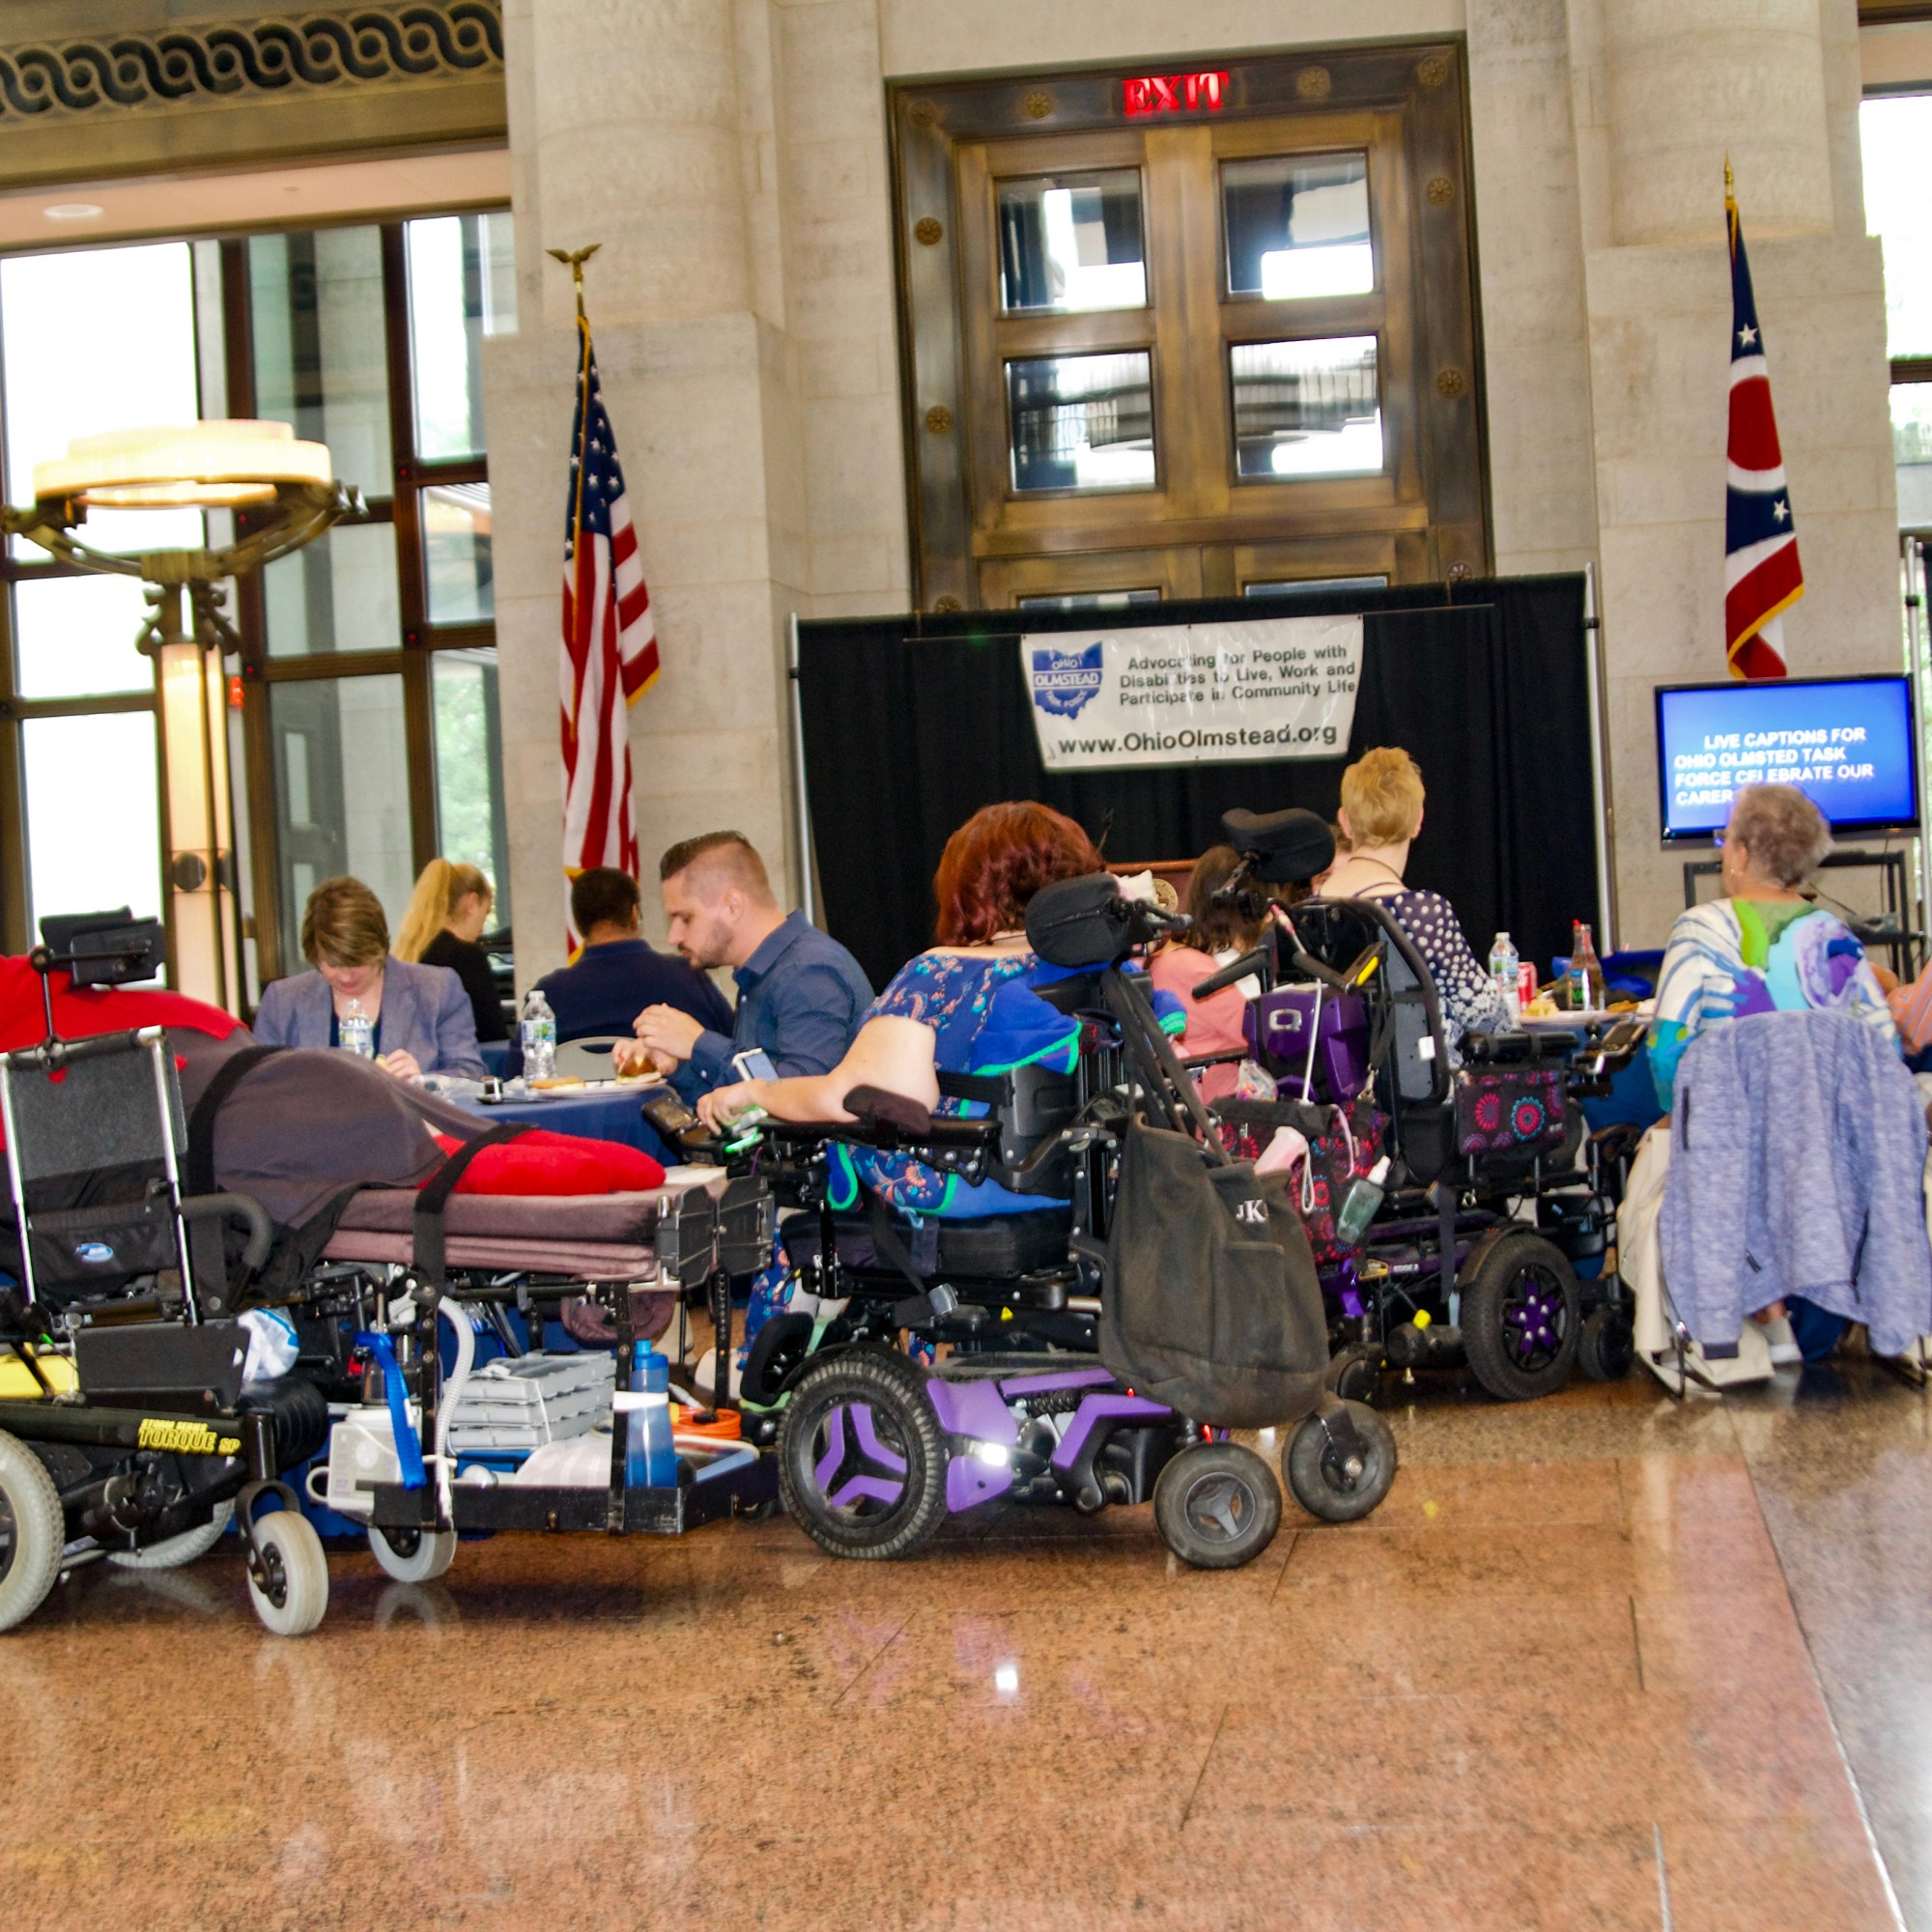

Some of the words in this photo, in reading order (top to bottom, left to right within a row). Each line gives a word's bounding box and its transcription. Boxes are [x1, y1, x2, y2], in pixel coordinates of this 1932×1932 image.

[1122, 71, 1230, 116] EXIT
[1051, 658, 1079, 670] OHIO
[1128, 653, 1216, 669] Advocaing
[1252, 646, 1306, 663] People
[1314, 644, 1347, 659] with
[1035, 671, 1099, 687] OLMSTEAD
[1120, 670, 1206, 689] Disabities
[1213, 670, 1230, 683] to
[1236, 668, 1272, 682] Live,
[1279, 664, 1319, 678] Work
[1326, 662, 1355, 676] and
[1232, 682, 1321, 698] Community
[1327, 680, 1355, 694] Life
[1058, 724, 1337, 753] www.OhioOlmstead.org
[1704, 733, 1741, 750] LIVE
[1744, 729, 1827, 748] CAPTIONS
[1831, 726, 1866, 743] FOR
[1674, 753, 1717, 770] OHIO
[1719, 749, 1799, 767] OLMSTED
[1802, 746, 1846, 762] TASK
[1675, 770, 1732, 788] FORCE
[1836, 762, 1873, 779] OUR
[138, 1428, 217, 1456] TORQUE
[217, 1437, 242, 1457] SP
